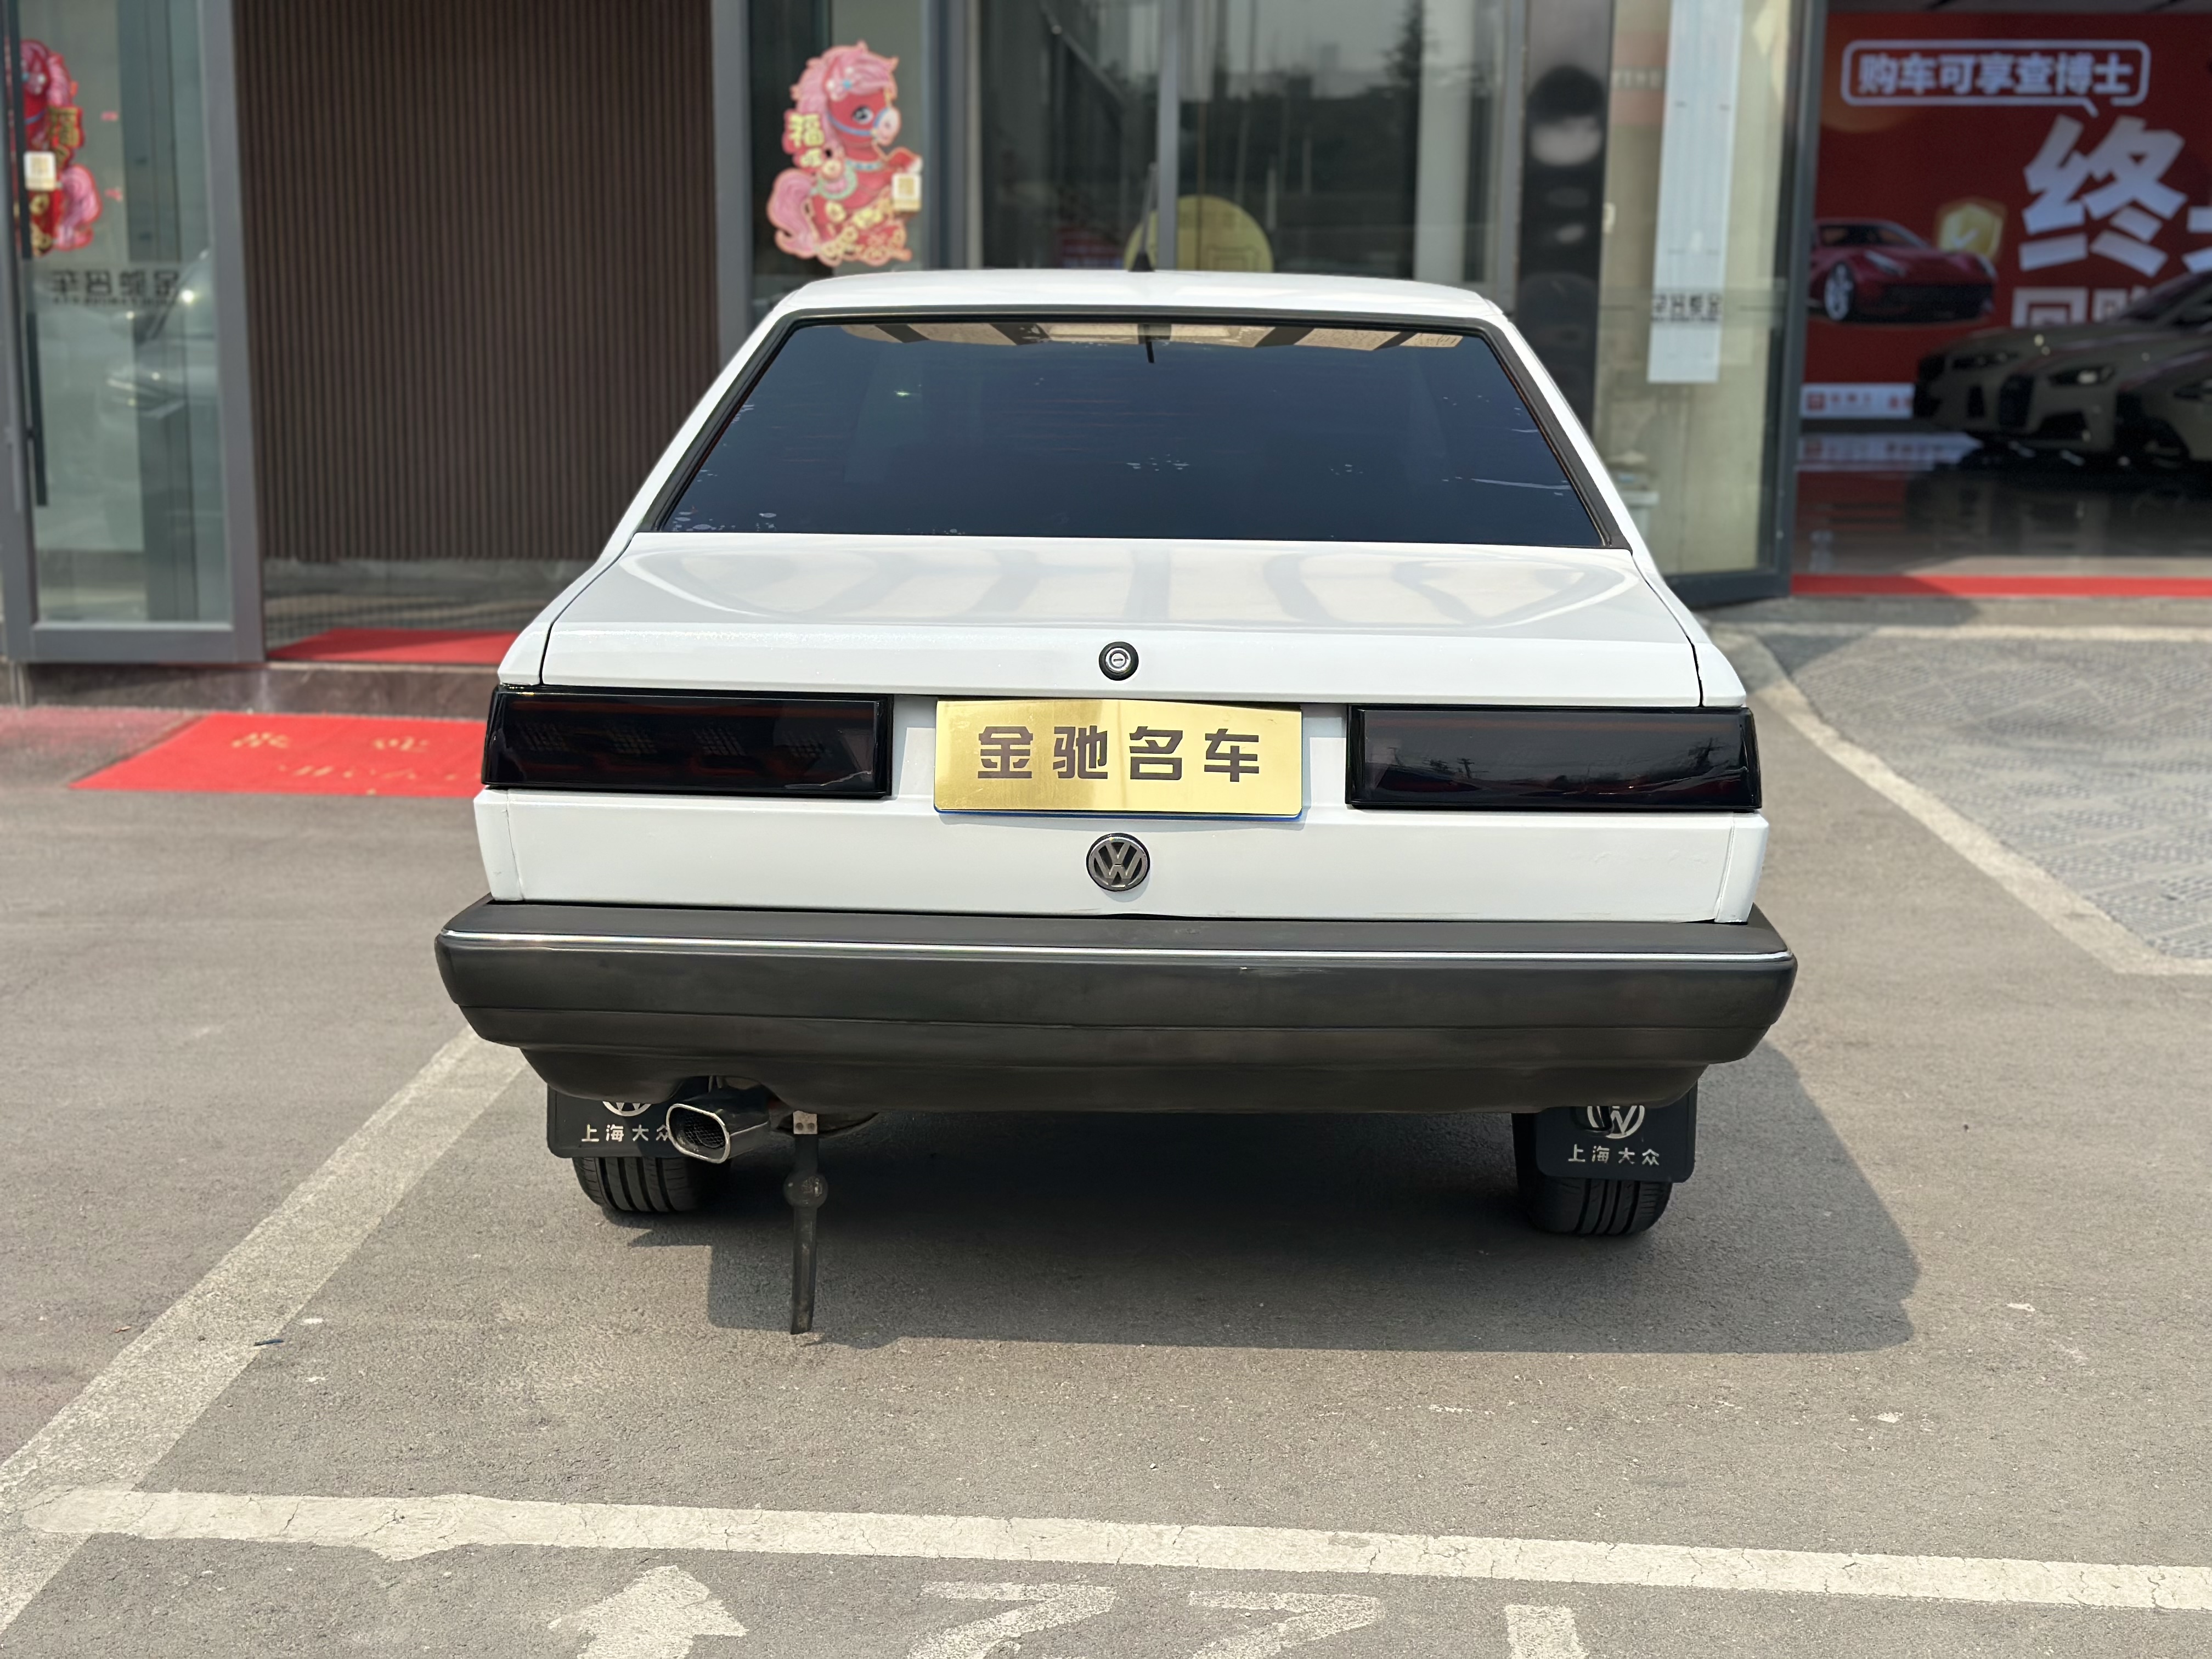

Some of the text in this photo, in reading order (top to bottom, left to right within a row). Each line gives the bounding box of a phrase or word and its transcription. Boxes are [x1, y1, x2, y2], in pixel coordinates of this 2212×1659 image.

[1858, 52, 2134, 95] 购车可享查博士
[2018, 113, 2212, 278] 终
[977, 725, 1260, 783] 金驰名车
[1568, 1144, 1660, 1166] 上海大众
